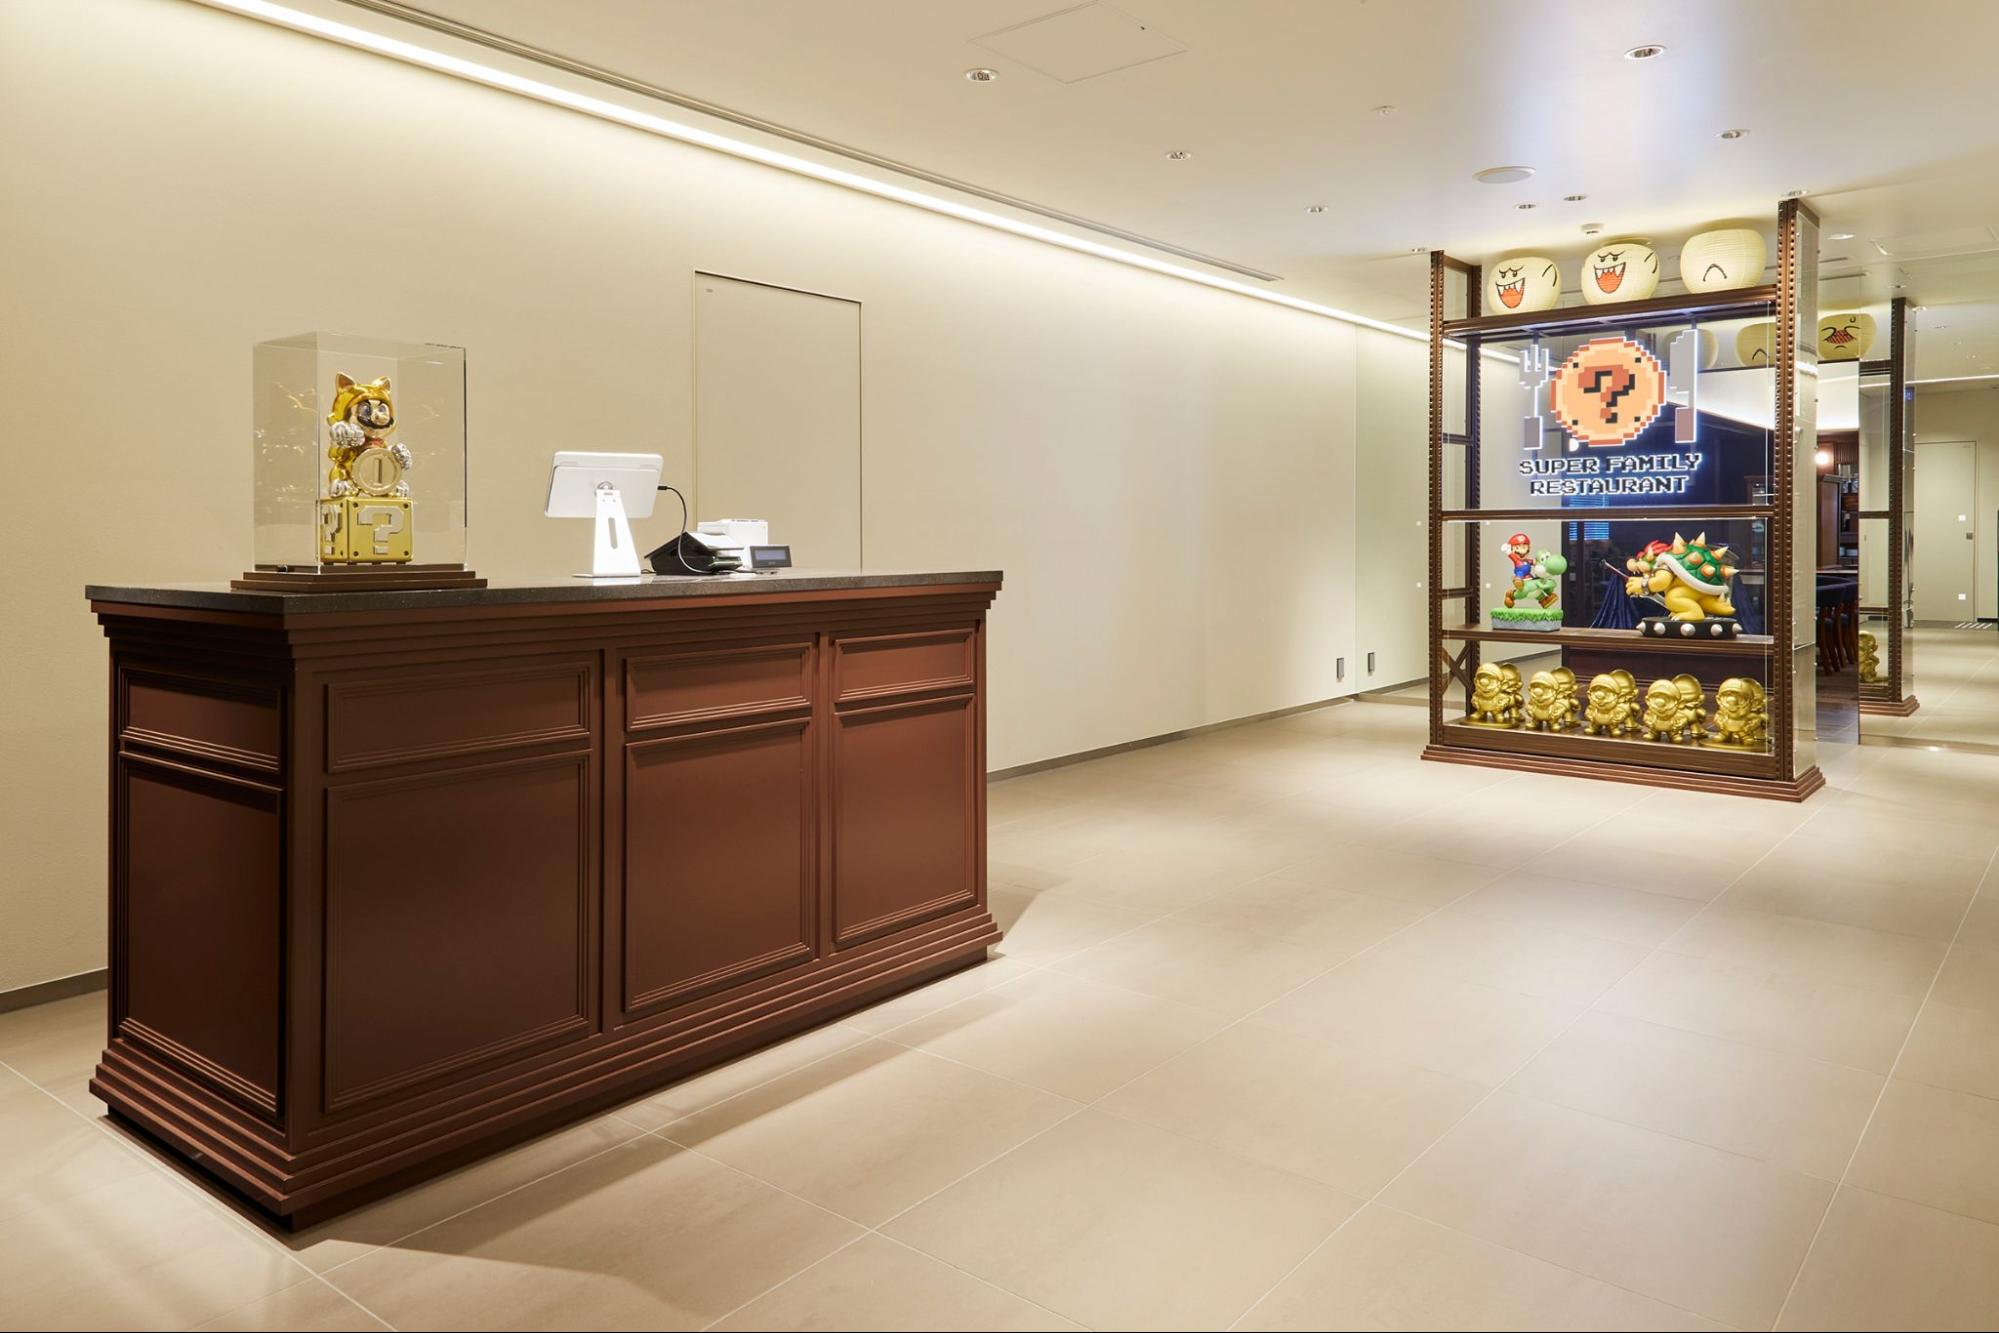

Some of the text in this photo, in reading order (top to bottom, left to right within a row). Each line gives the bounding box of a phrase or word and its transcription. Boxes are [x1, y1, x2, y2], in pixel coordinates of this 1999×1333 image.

[1519, 453, 1702, 476] SUPER FAMILY
[1530, 475, 1690, 496] RESTAURANT
[357, 505, 404, 555] ?
